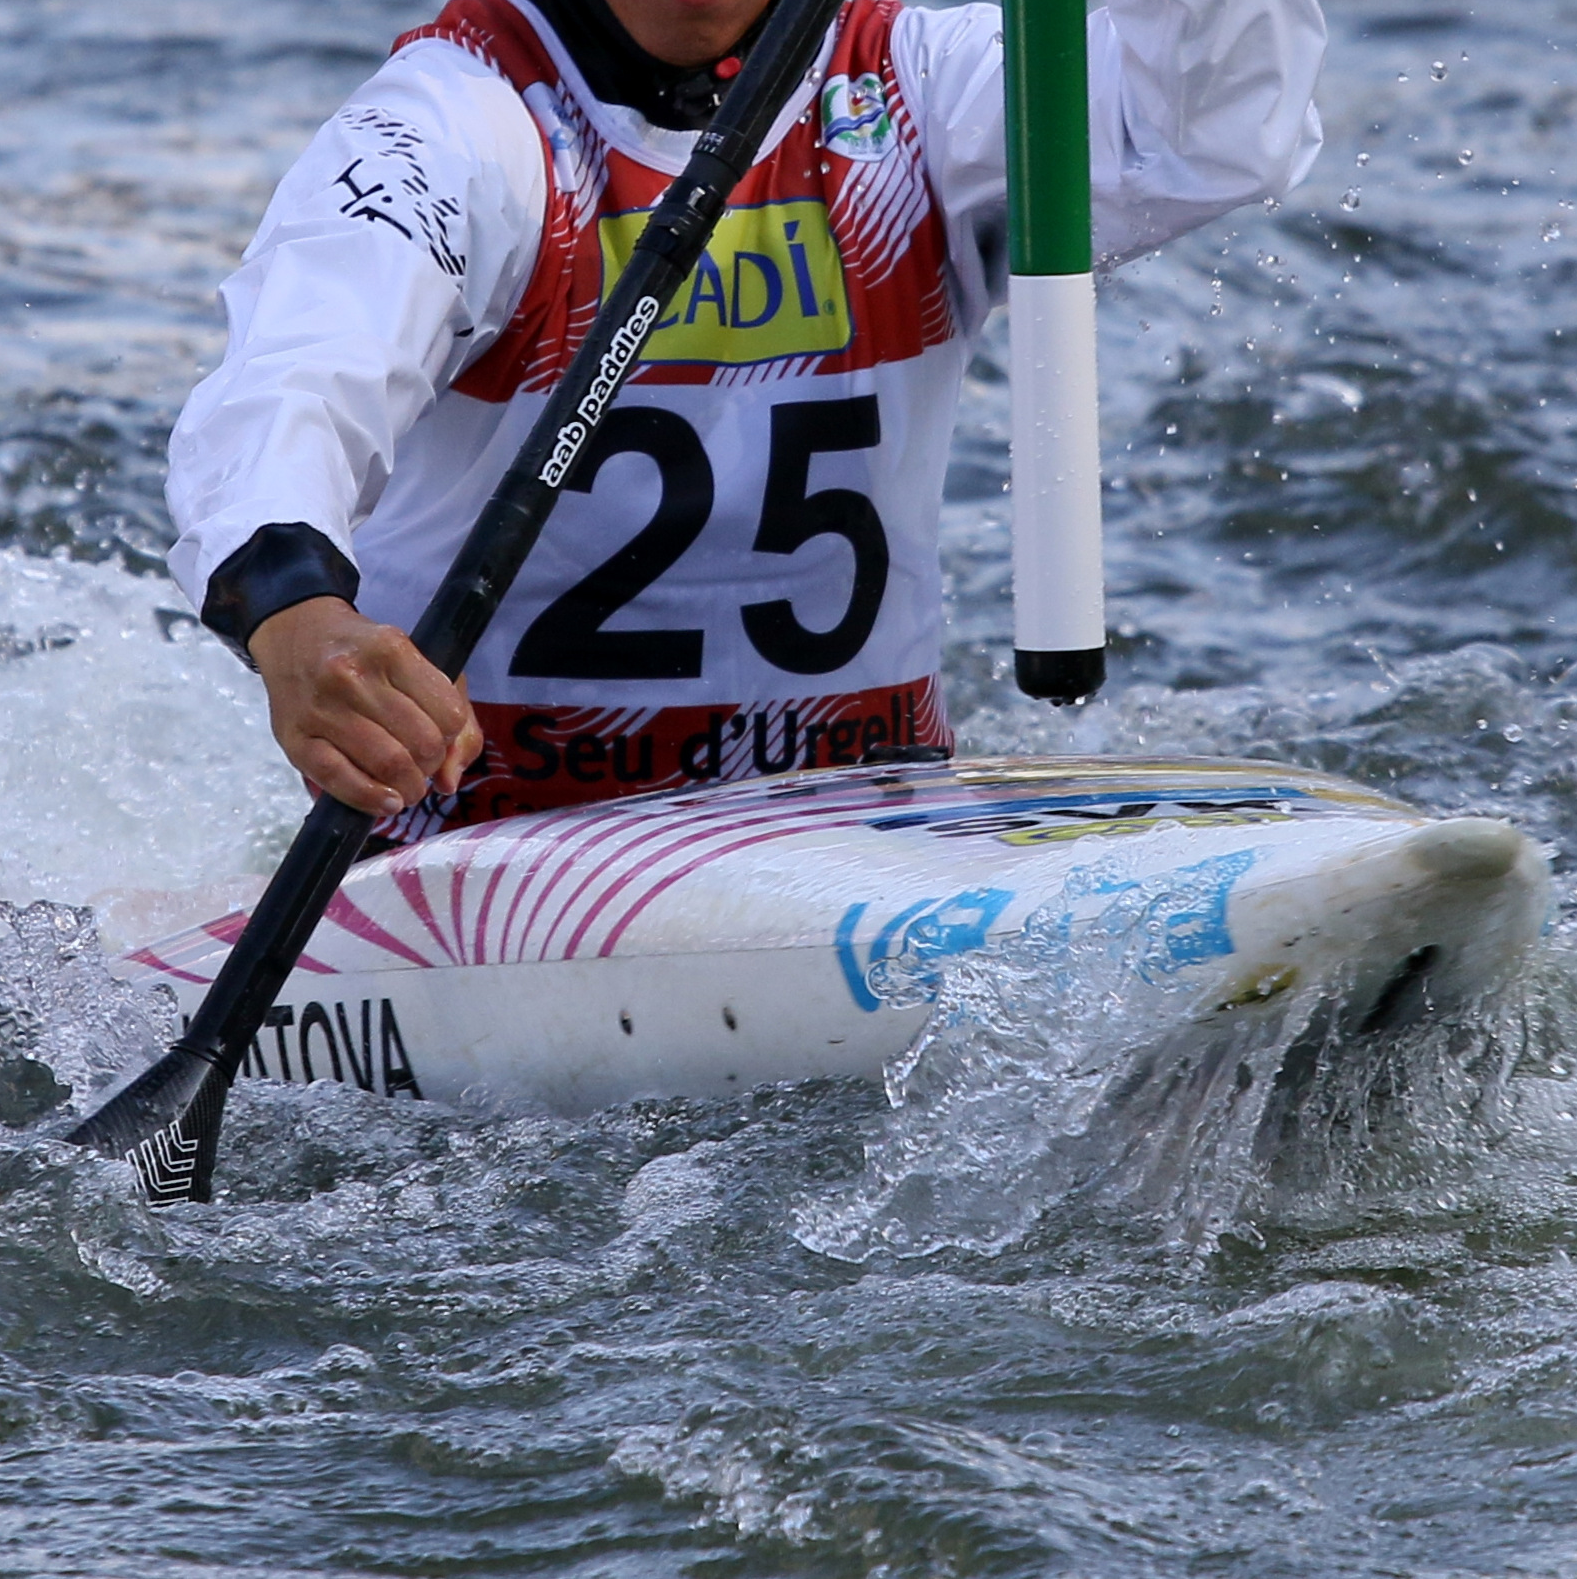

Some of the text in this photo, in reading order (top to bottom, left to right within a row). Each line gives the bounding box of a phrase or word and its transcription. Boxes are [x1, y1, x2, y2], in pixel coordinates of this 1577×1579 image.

[653, 220, 820, 330] ADÍ
[539, 296, 660, 488] aab paddles
[508, 394, 890, 678] 25
[512, 714, 654, 783] Seu
